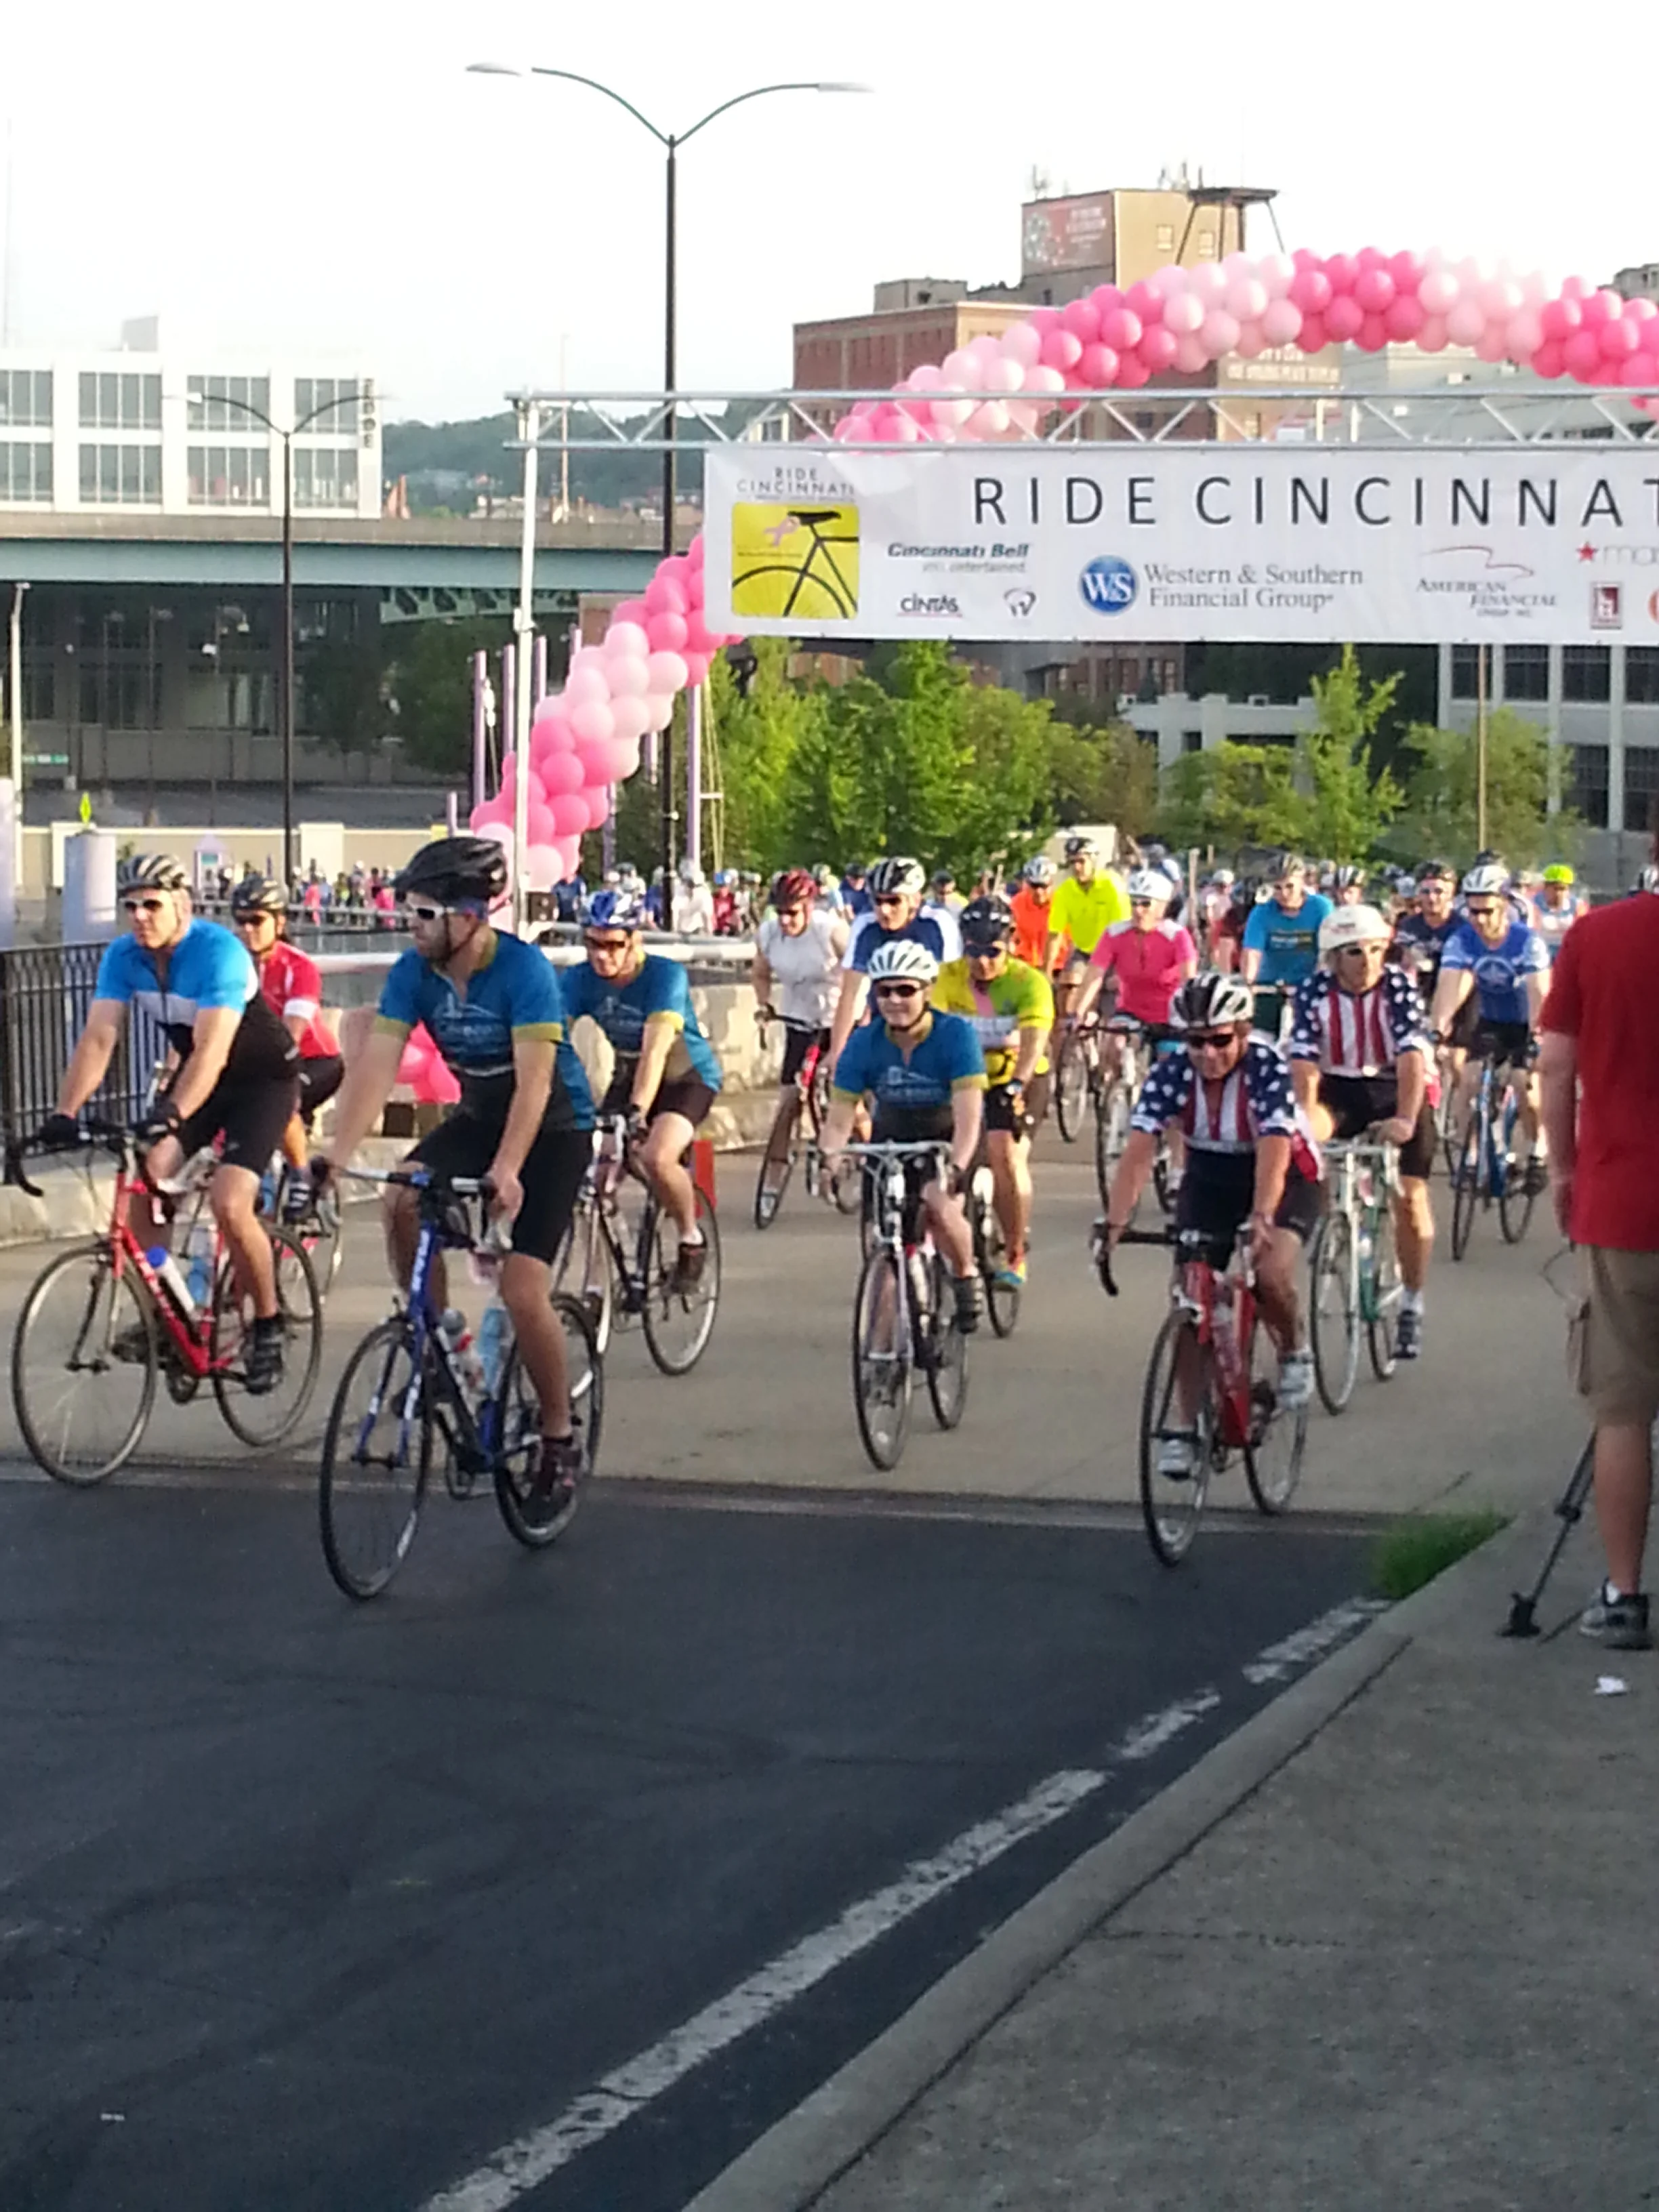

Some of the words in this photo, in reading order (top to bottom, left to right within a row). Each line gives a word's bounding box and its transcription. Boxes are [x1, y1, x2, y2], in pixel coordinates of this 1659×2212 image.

[774, 467, 817, 480] RIDE
[737, 478, 854, 495] CINCINNATI
[975, 477, 1157, 525] RIDE
[888, 543, 985, 557] Cincinnati
[991, 544, 1029, 557] Bell
[1145, 564, 1231, 584] Western
[1237, 565, 1256, 584] &
[1266, 565, 1363, 585] Southern
[1150, 588, 1248, 607] Financial
